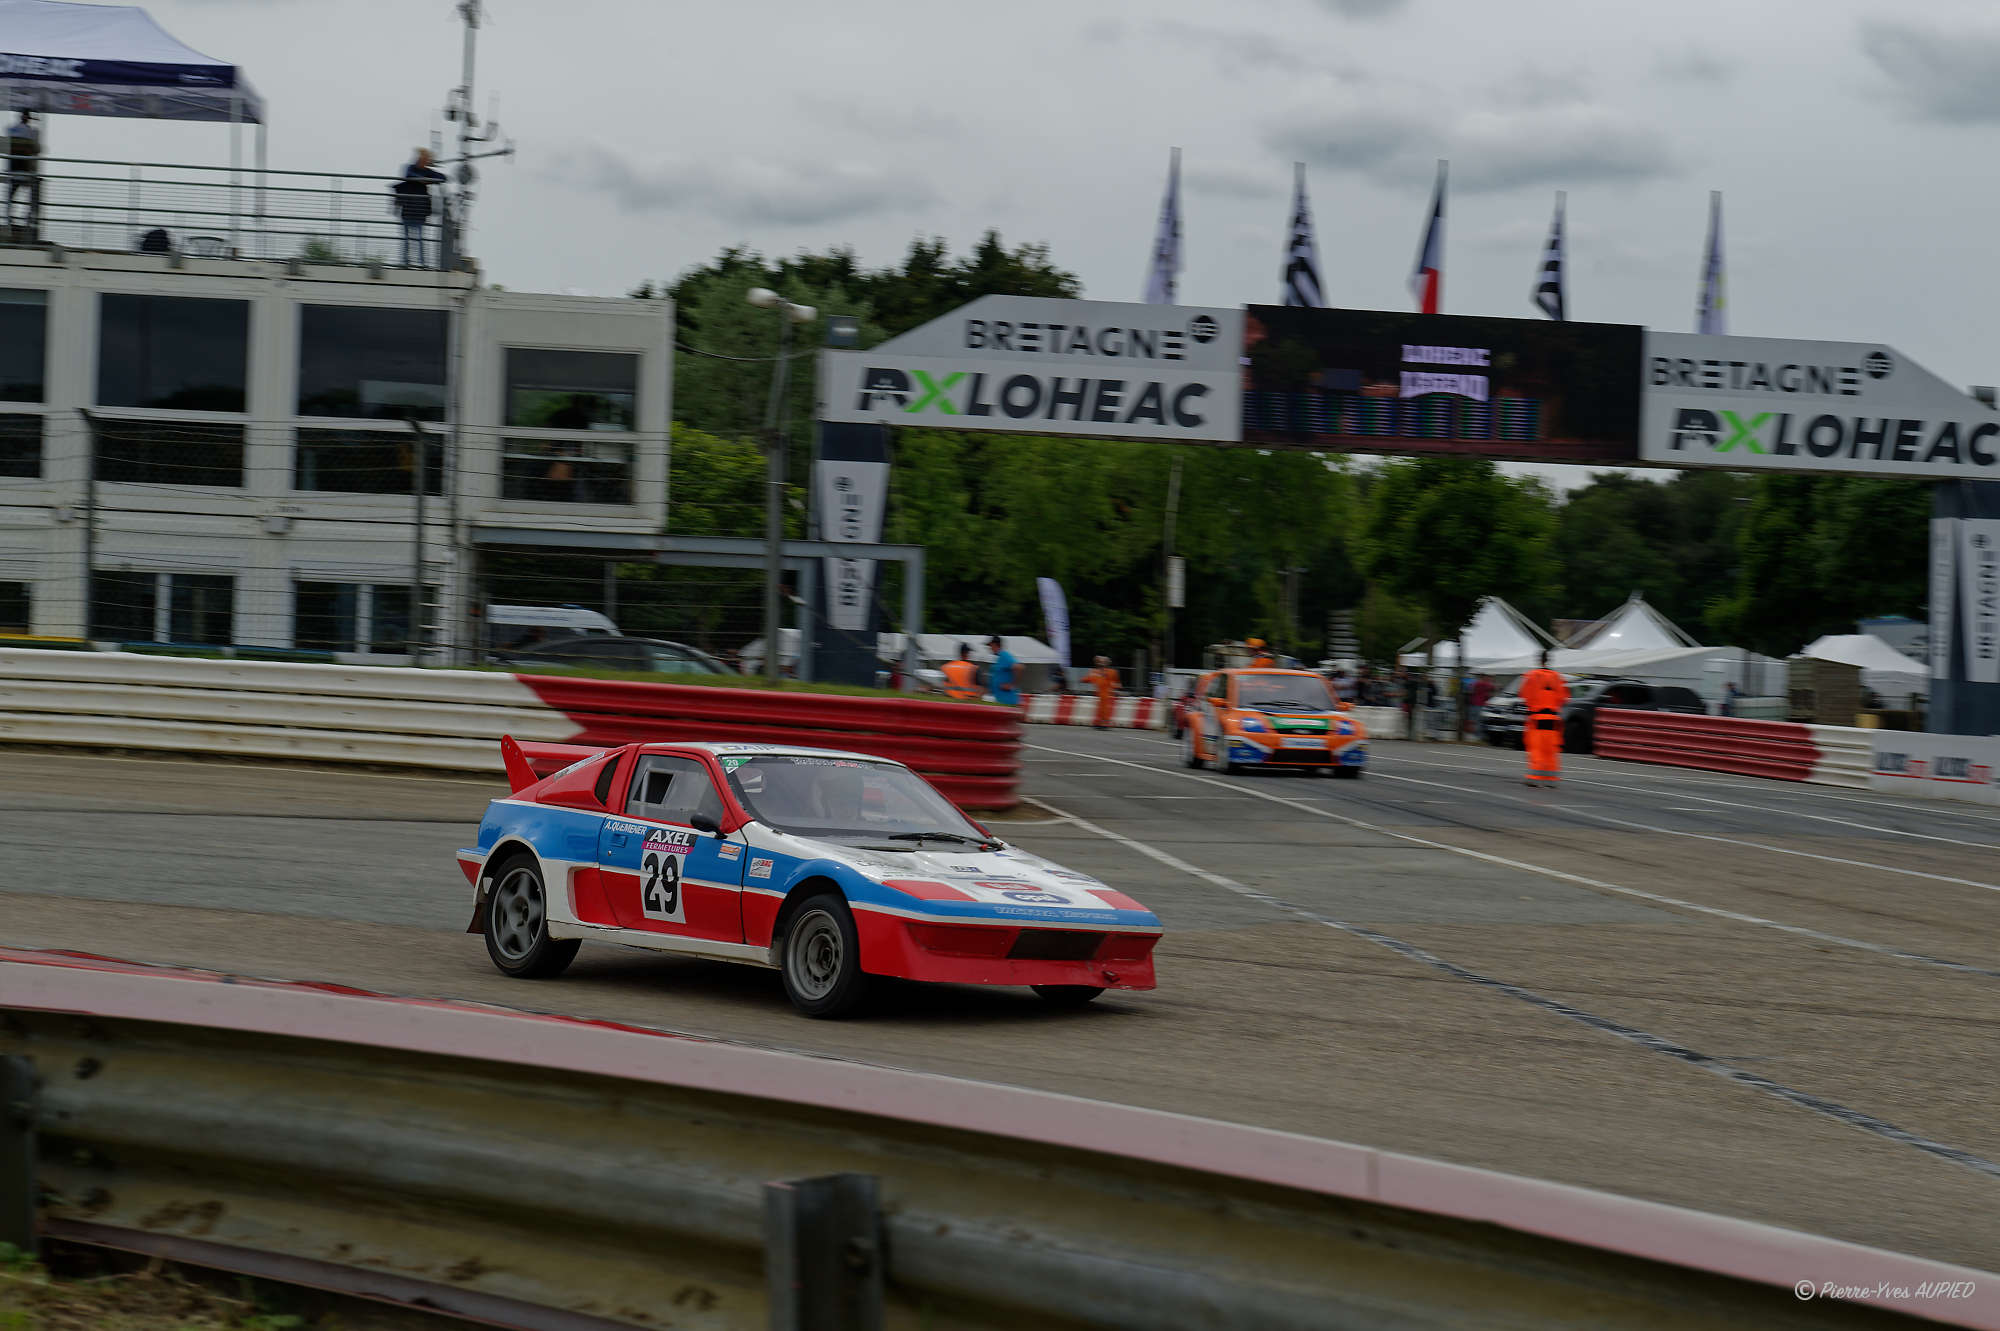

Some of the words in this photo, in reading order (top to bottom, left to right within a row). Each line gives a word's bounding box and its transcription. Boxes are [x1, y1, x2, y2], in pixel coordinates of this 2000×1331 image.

[966, 319, 1186, 361] BRETAGNE
[1649, 357, 1861, 396] BRETAGNE
[645, 842, 689, 854] FERMETURES
[649, 829, 690, 846] AXEL
[643, 852, 680, 915] 29
